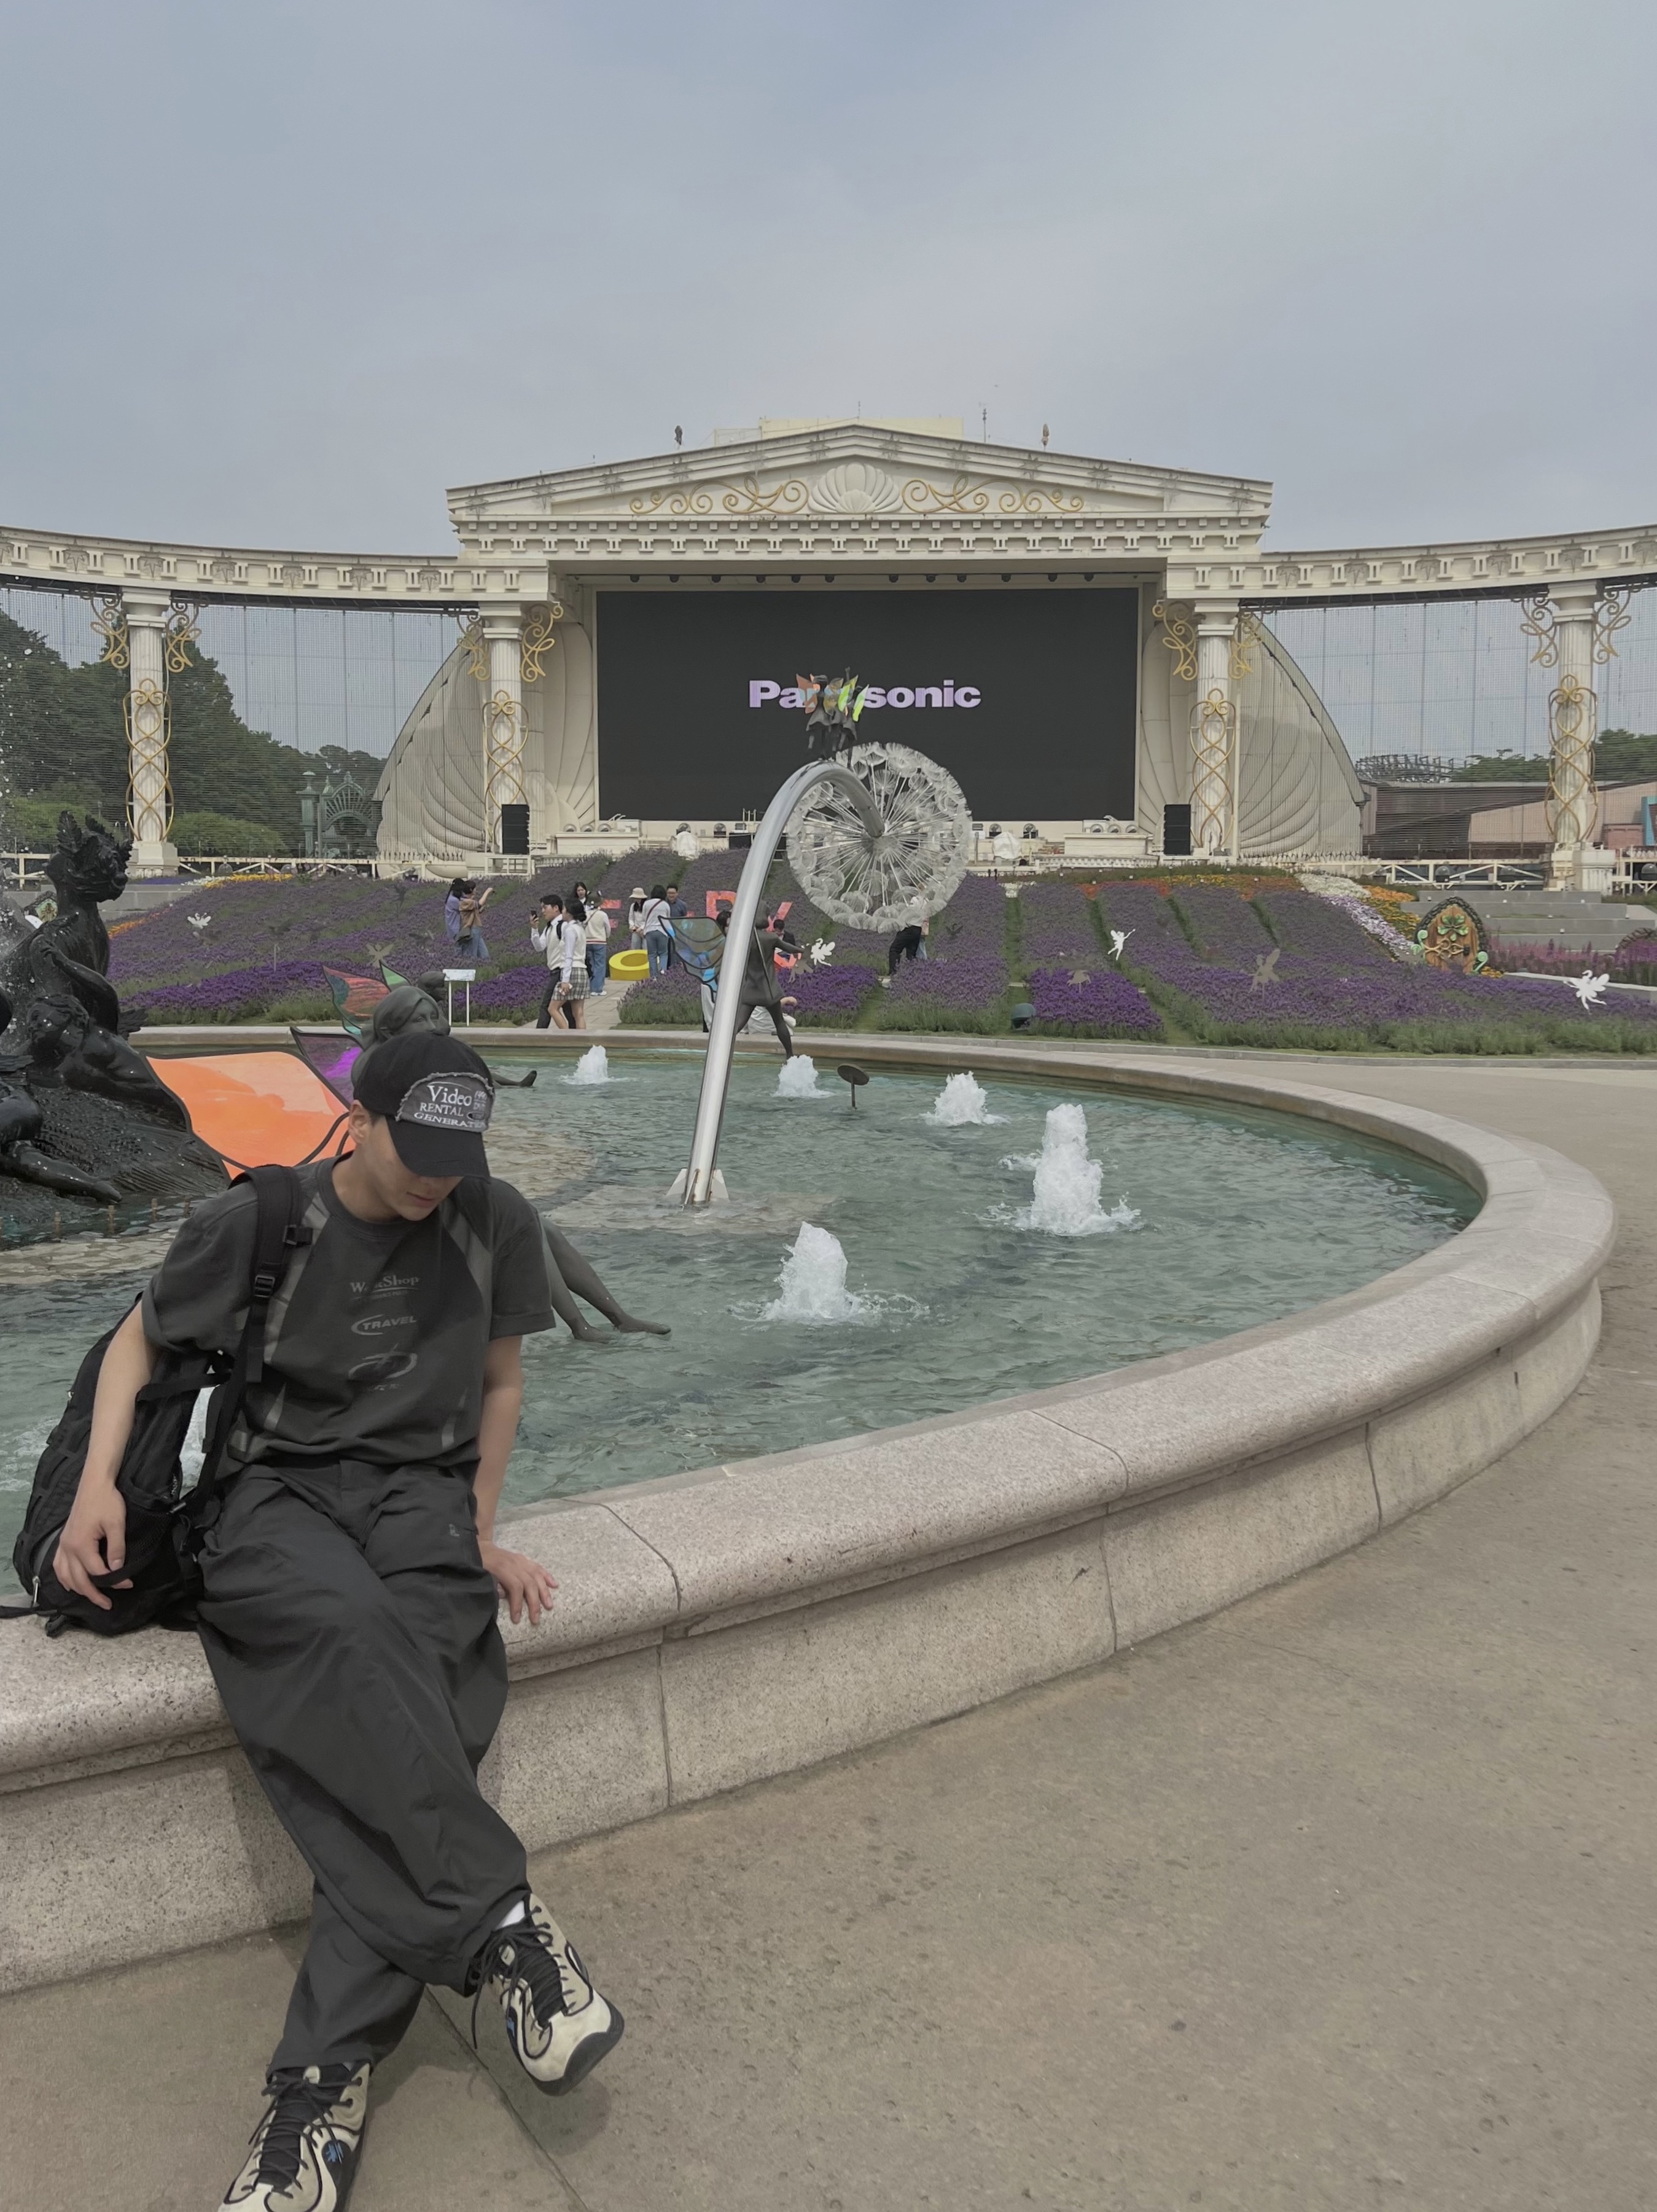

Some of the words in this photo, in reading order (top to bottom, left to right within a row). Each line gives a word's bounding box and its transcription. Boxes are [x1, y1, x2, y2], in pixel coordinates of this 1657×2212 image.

[749, 679, 981, 709] Pasonic
[427, 1085, 472, 1107] Video
[419, 1102, 464, 1117] RENTAL
[362, 1315, 417, 1331] TRAVEL
